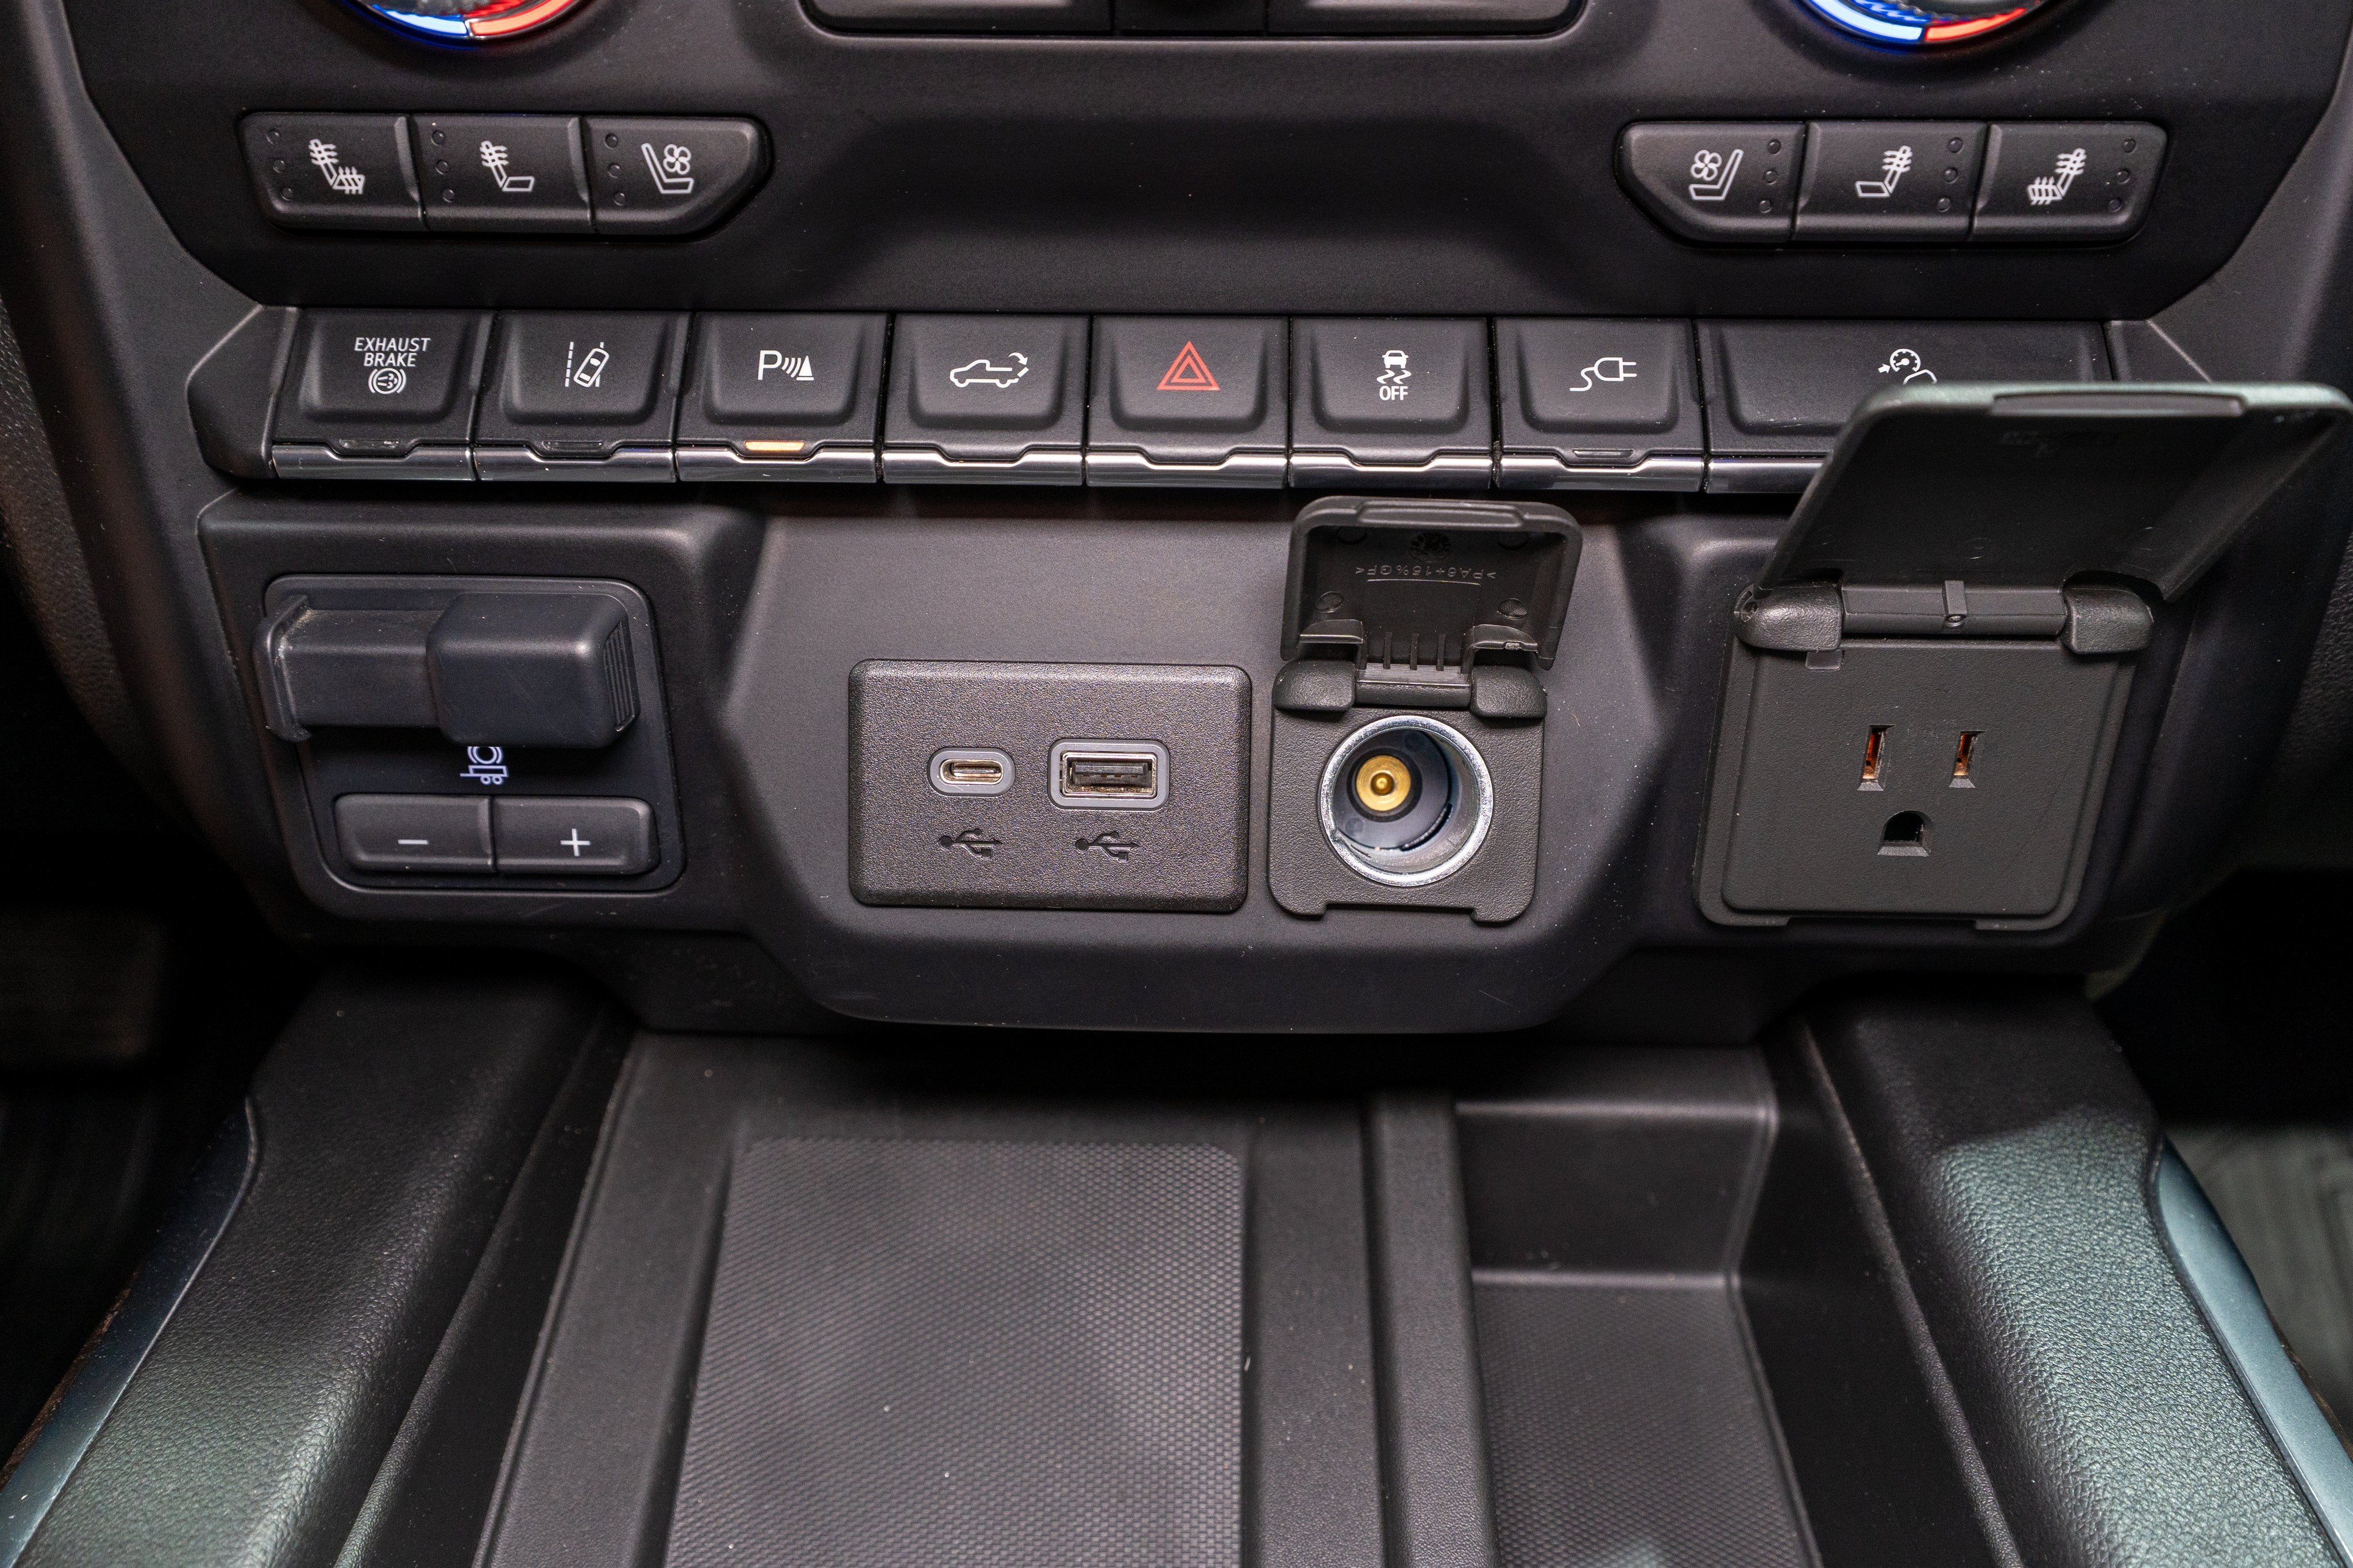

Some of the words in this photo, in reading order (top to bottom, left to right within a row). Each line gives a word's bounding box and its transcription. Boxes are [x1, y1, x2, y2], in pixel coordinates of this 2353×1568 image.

[354, 337, 431, 352] EXHAUST
[363, 352, 417, 367] BRAKE
[758, 350, 782, 380] P
[1379, 385, 1409, 401] OFF
